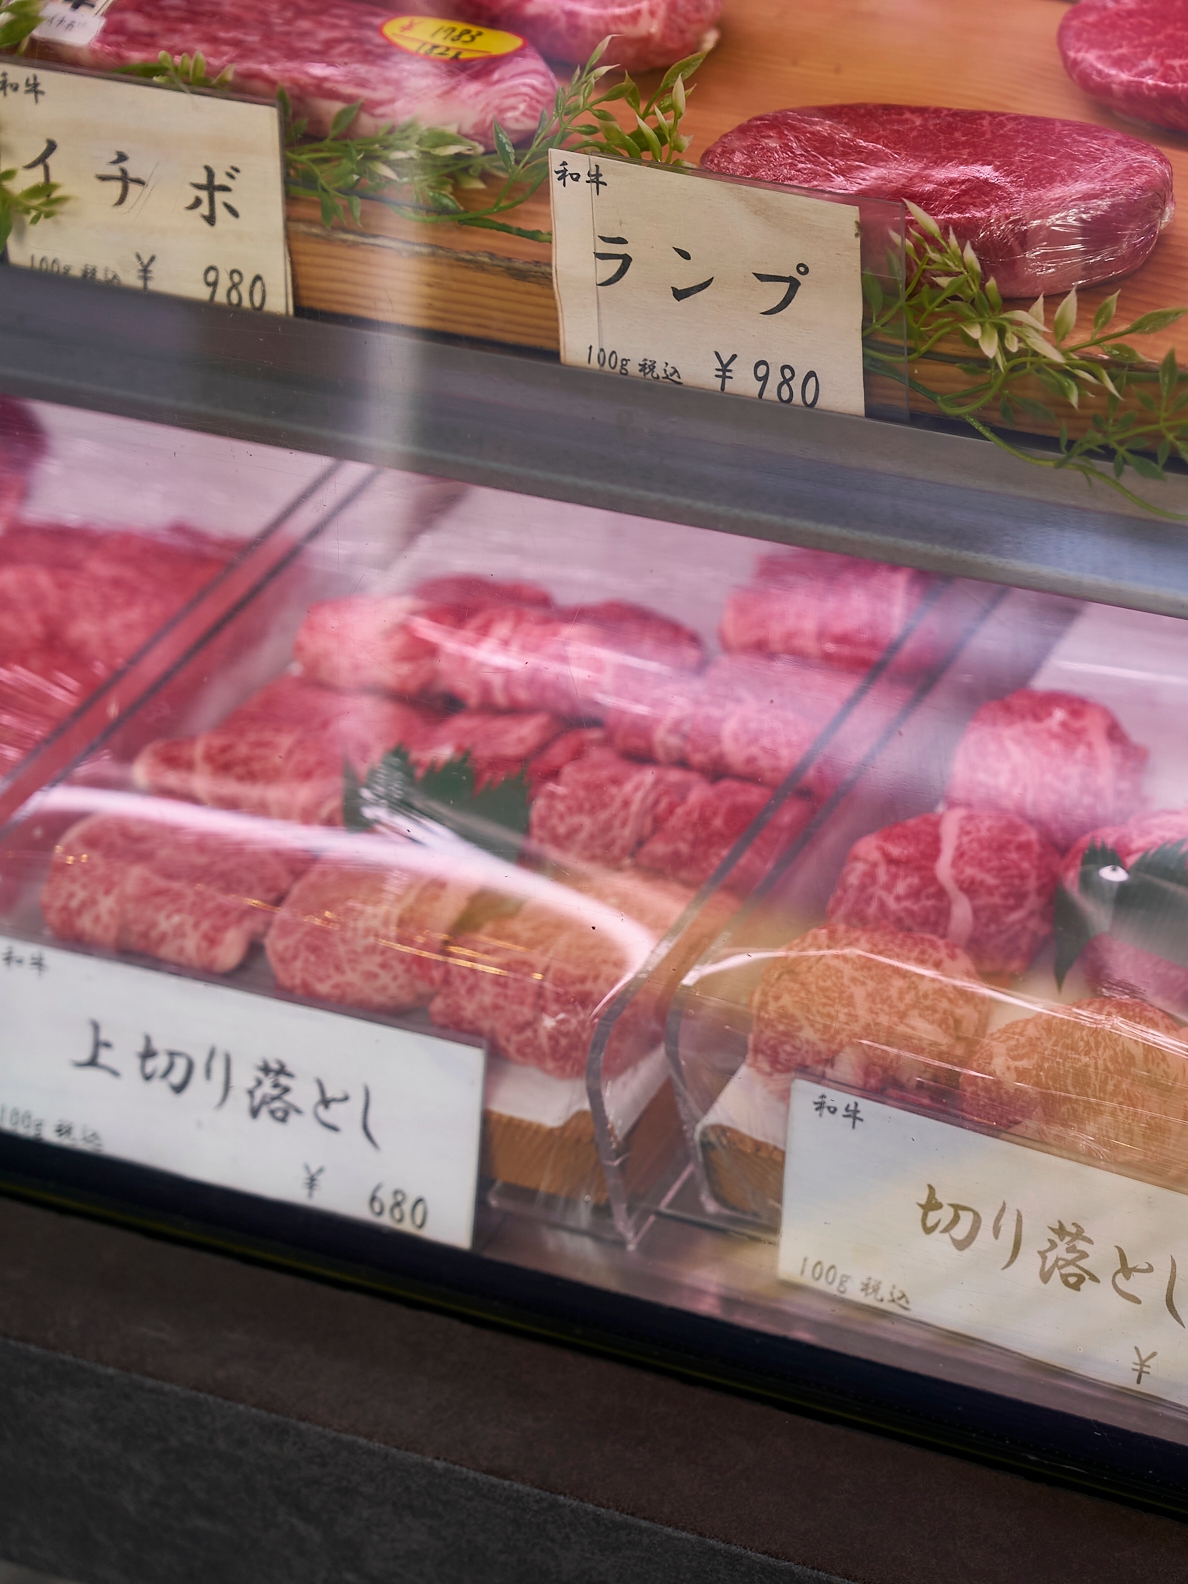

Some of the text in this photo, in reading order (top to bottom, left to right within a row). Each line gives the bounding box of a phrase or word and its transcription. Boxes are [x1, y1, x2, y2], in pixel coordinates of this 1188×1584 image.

[0, 71, 45, 104] 和牛
[22, 137, 241, 227] イチボ
[553, 161, 608, 196] 和牛
[135, 252, 266, 311] ¥ 980
[594, 235, 810, 316] ランプ
[587, 344, 684, 385] 100g 税込
[713, 350, 820, 408] ¥ 980
[2, 946, 48, 978] 和牛
[72, 1018, 380, 1151] 上切り落とし
[813, 1094, 864, 1130] 和牛
[304, 1163, 428, 1230] ¥ 680
[800, 1257, 911, 1311] 100g 税込
[916, 1183, 1186, 1329] 切り落とし
[1131, 1345, 1158, 1385] ¥
